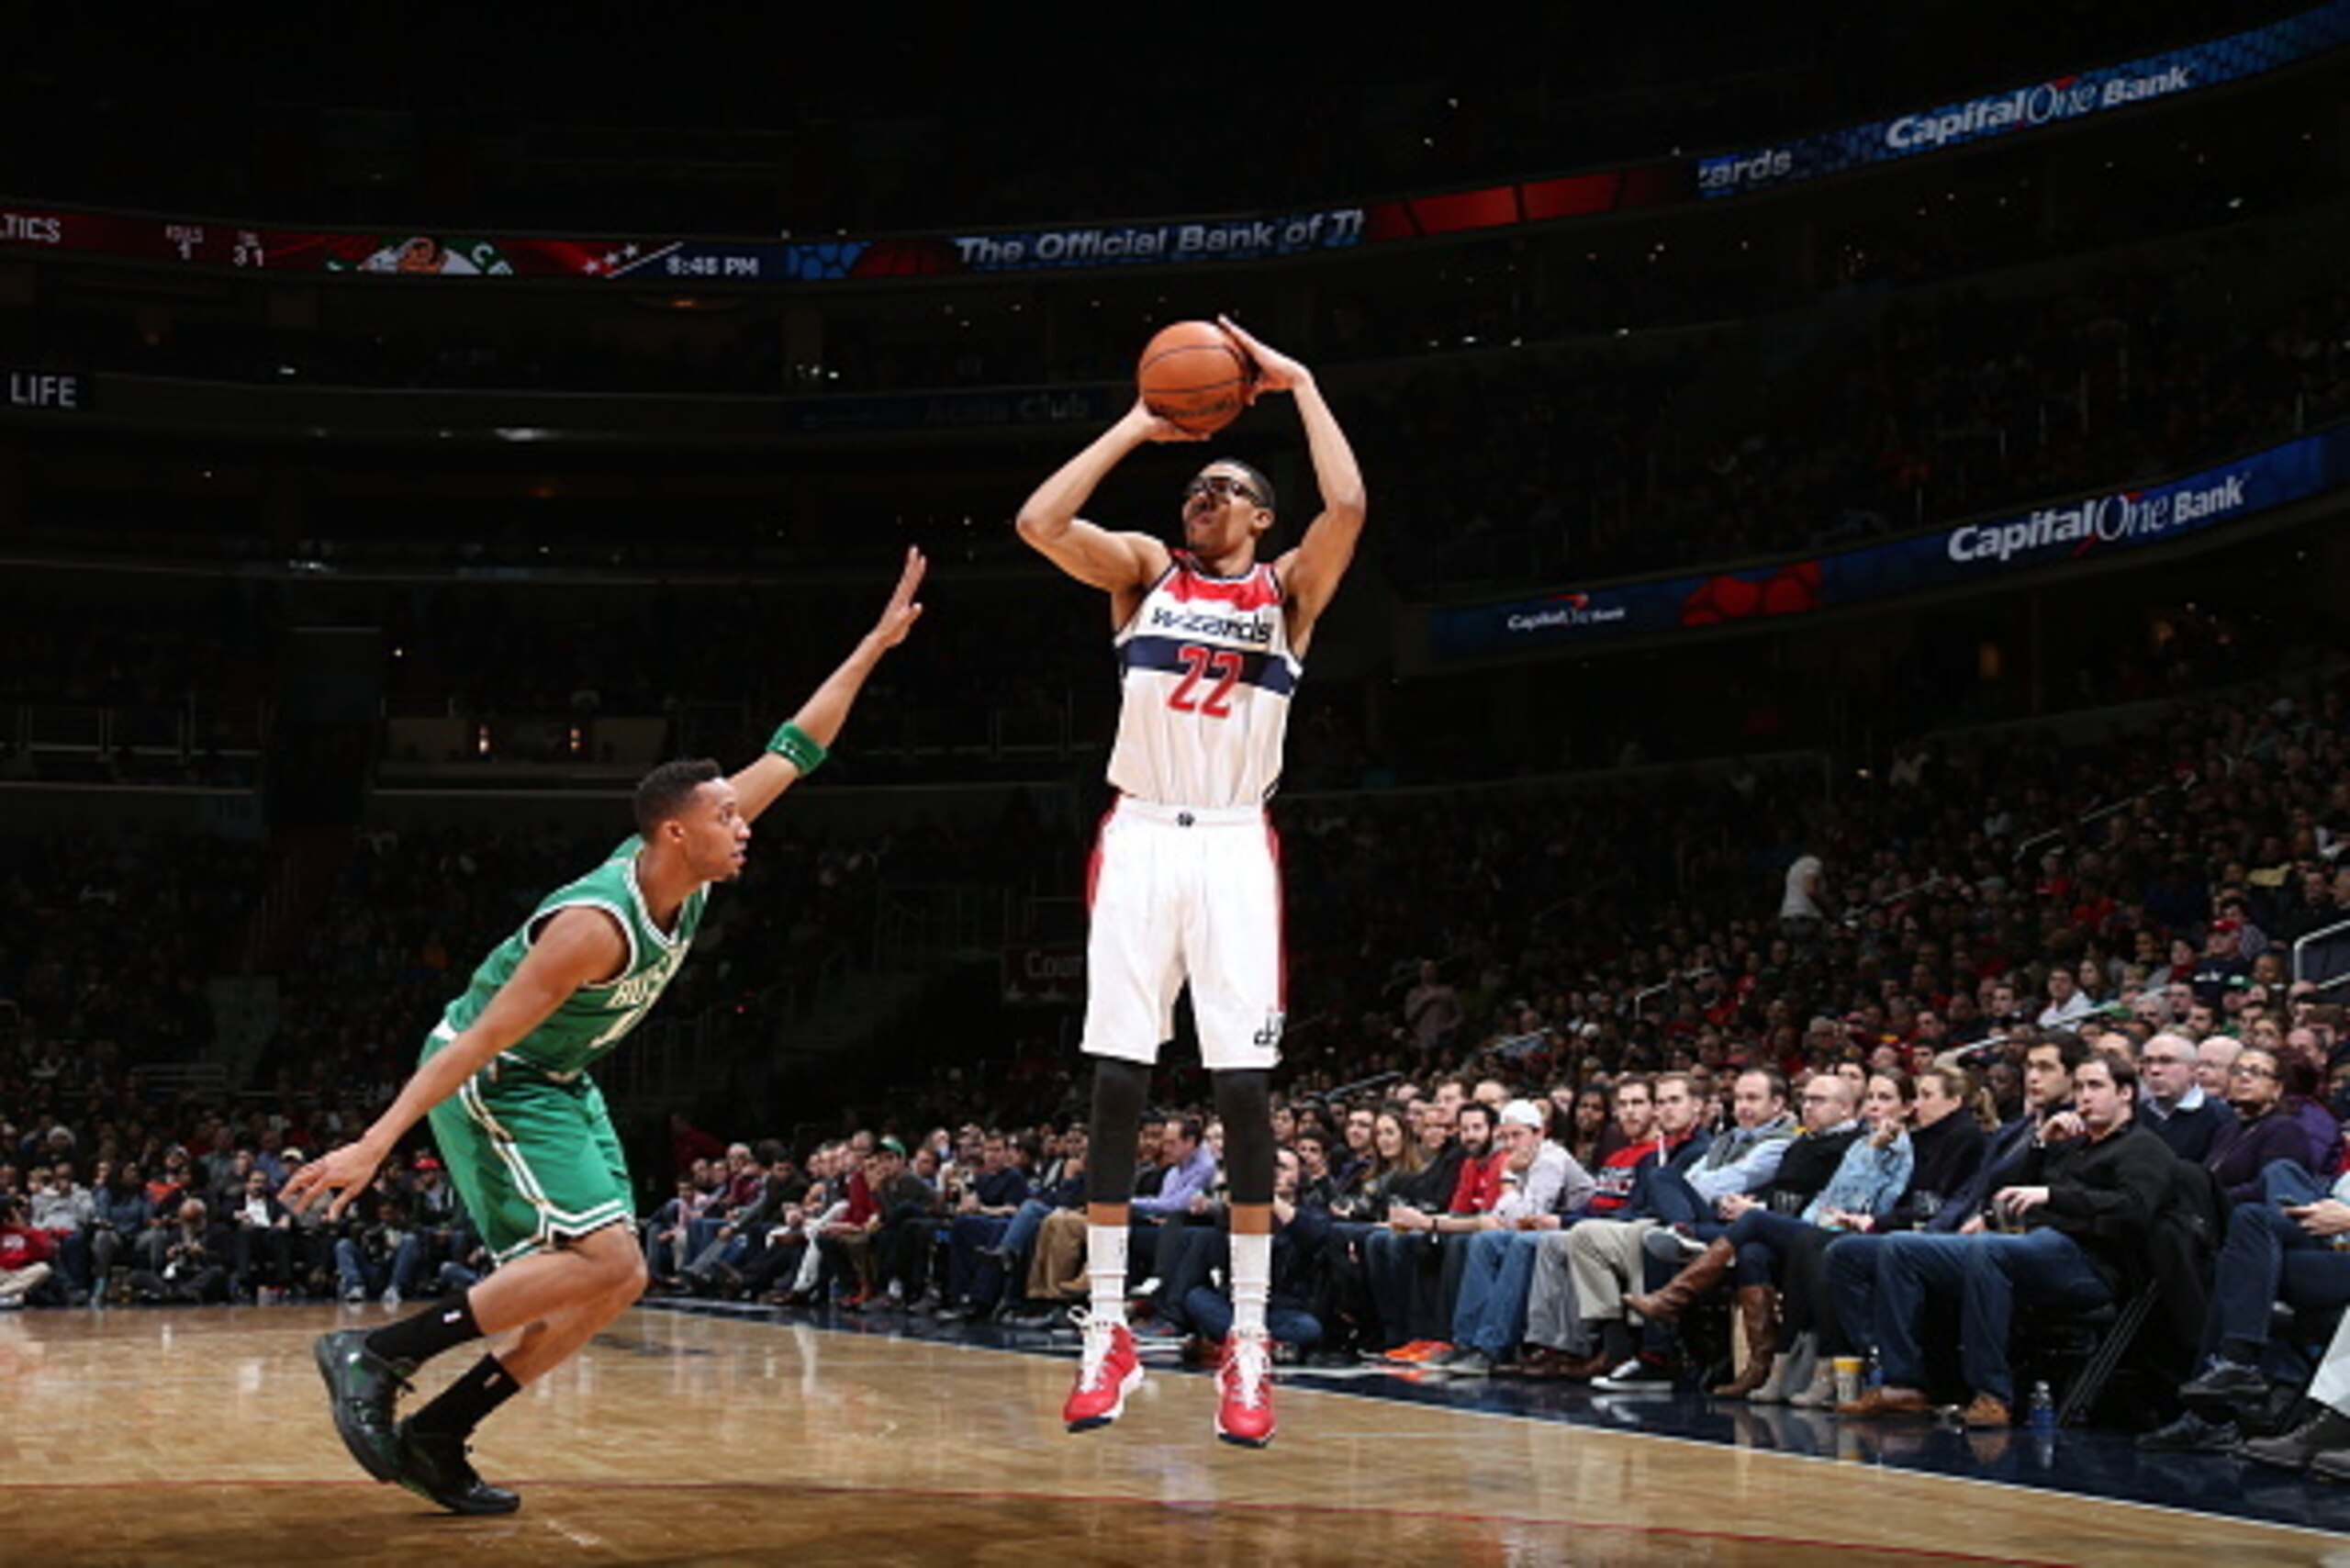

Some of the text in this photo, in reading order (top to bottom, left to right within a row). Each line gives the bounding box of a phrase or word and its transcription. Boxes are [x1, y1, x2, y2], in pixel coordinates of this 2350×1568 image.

[2102, 66, 2189, 108] Bank
[0, 214, 61, 243] TICS
[956, 236, 1024, 263] The
[1036, 229, 1168, 260] Official
[1178, 221, 1275, 252] Bank
[1285, 213, 1324, 244] of
[724, 256, 759, 276] PM
[11, 372, 77, 408] LIFE
[2173, 476, 2245, 525] Bank
[1167, 643, 1244, 718] 22
